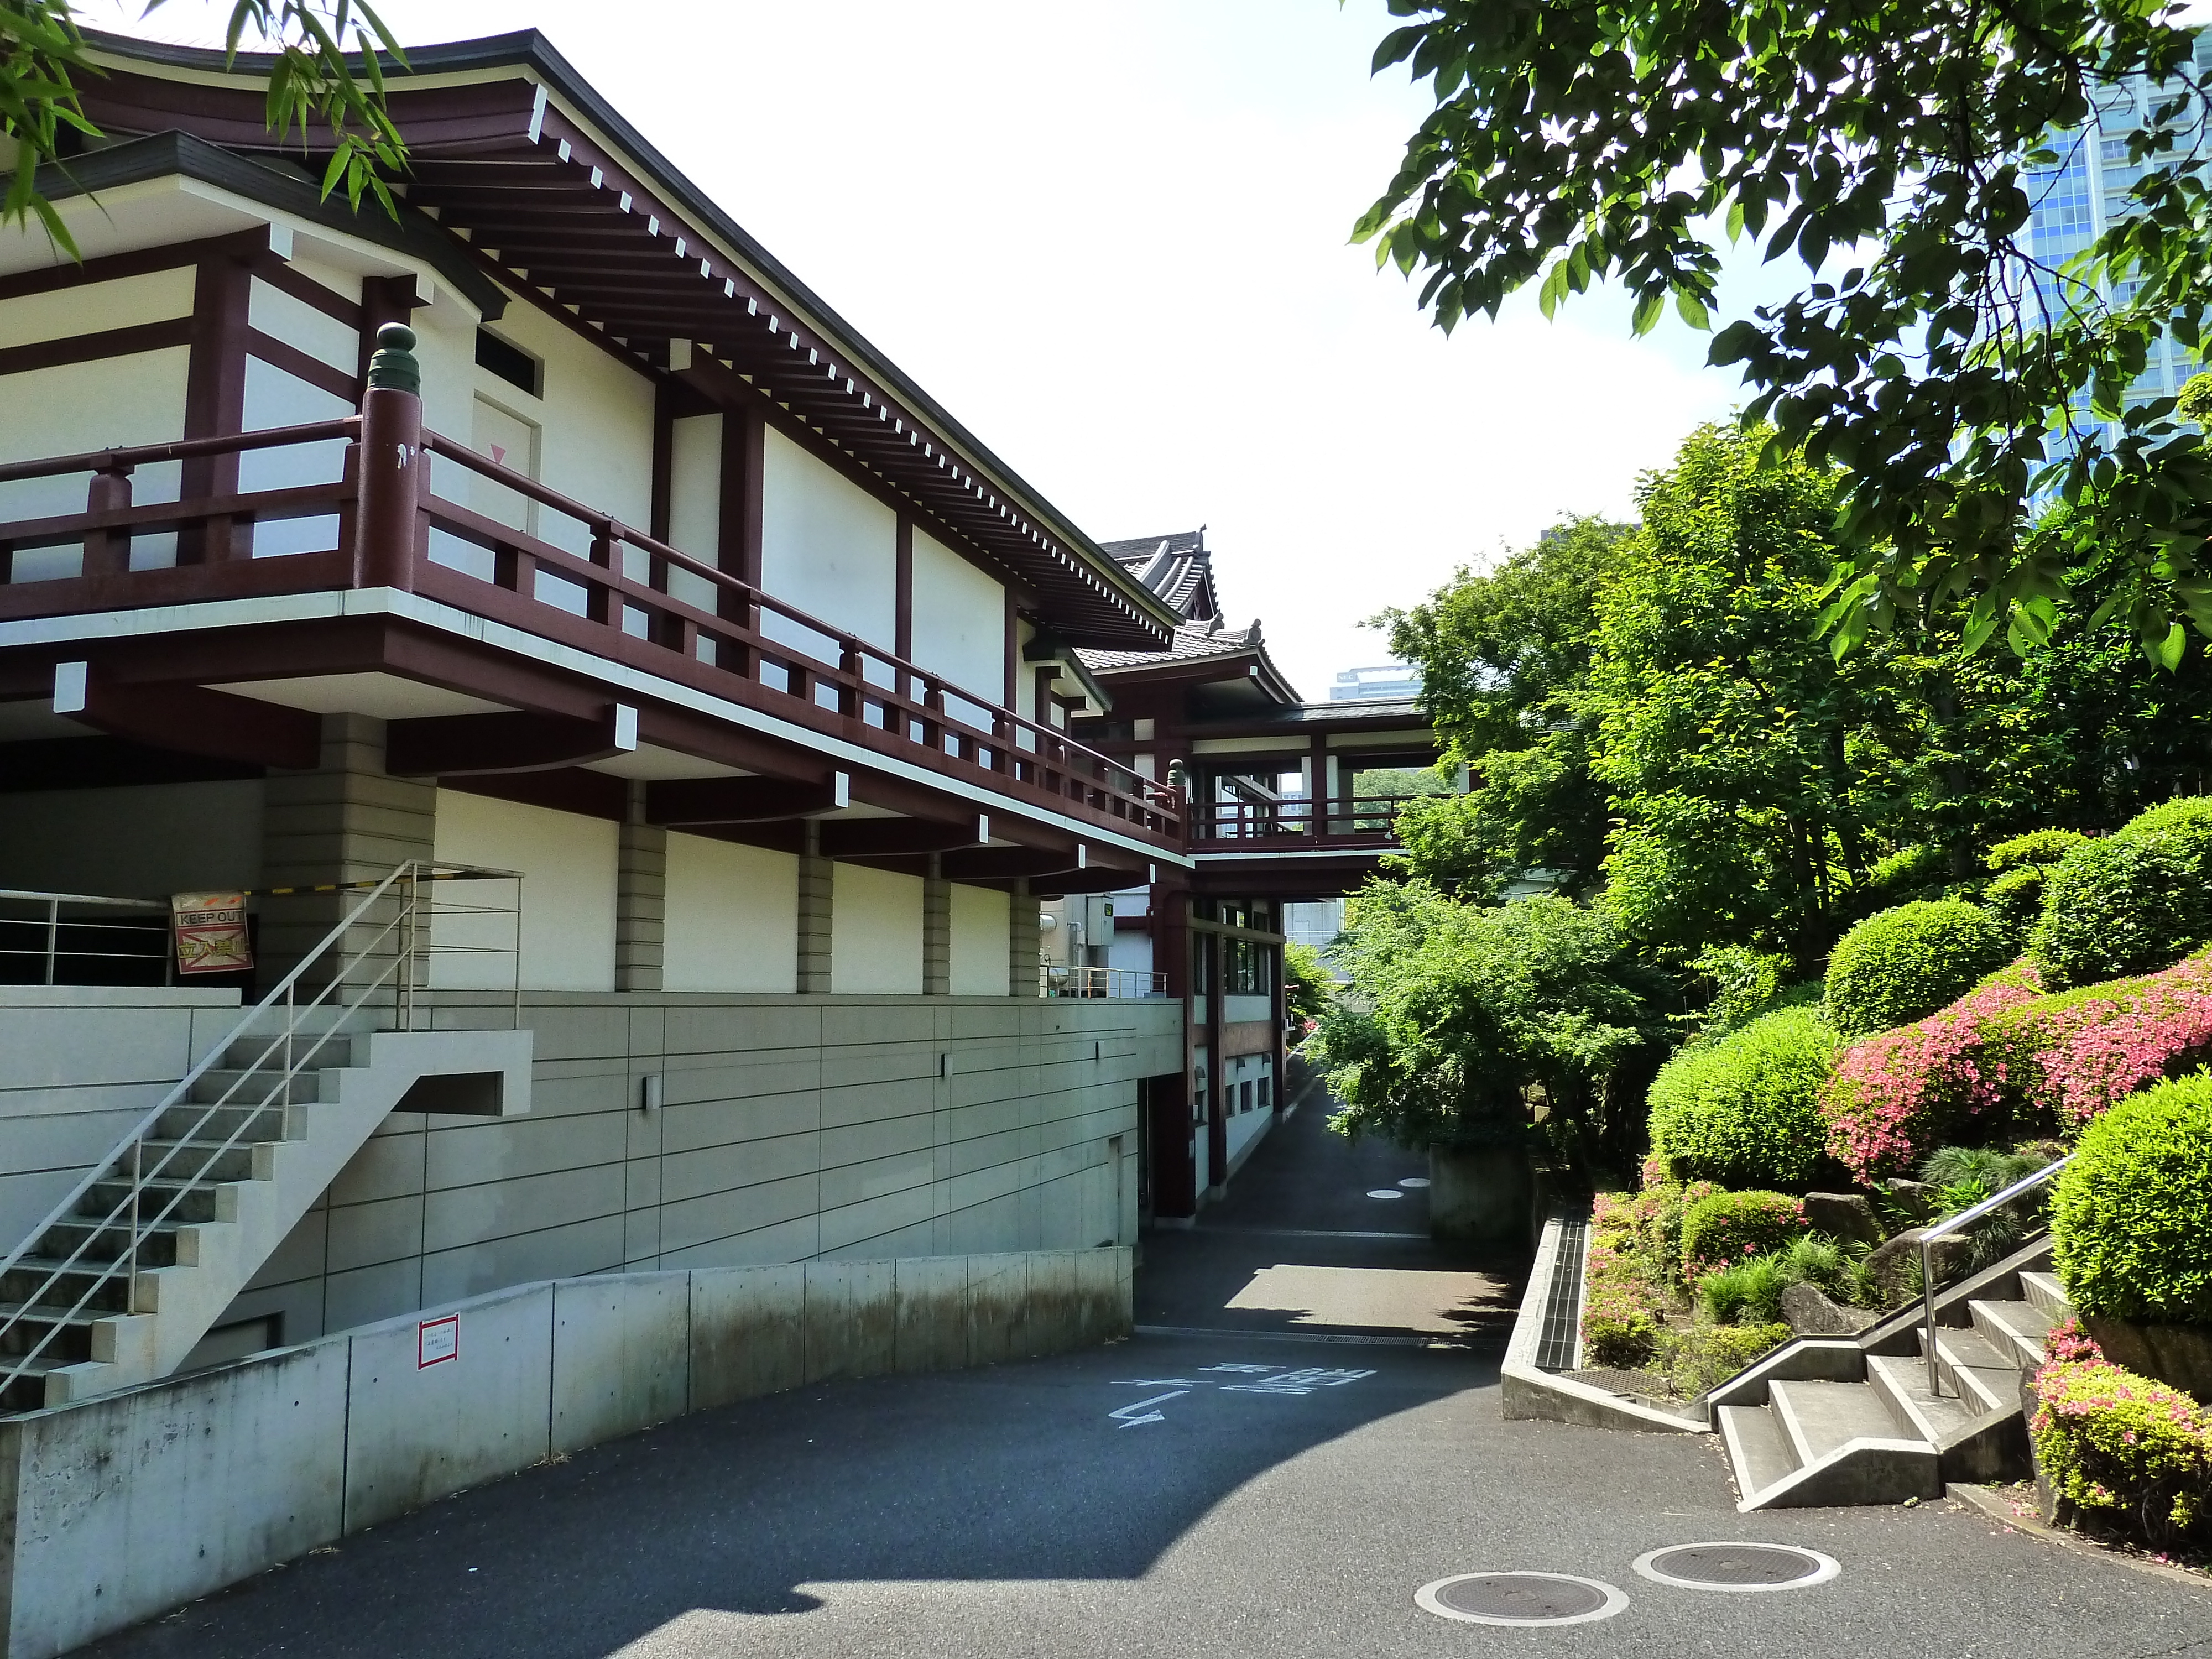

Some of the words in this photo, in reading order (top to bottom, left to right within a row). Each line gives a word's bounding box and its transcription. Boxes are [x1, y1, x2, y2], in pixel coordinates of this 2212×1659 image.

[180, 912, 215, 925] KEEP
[218, 911, 243, 922] OUT
[178, 938, 250, 959] 立入禁止
